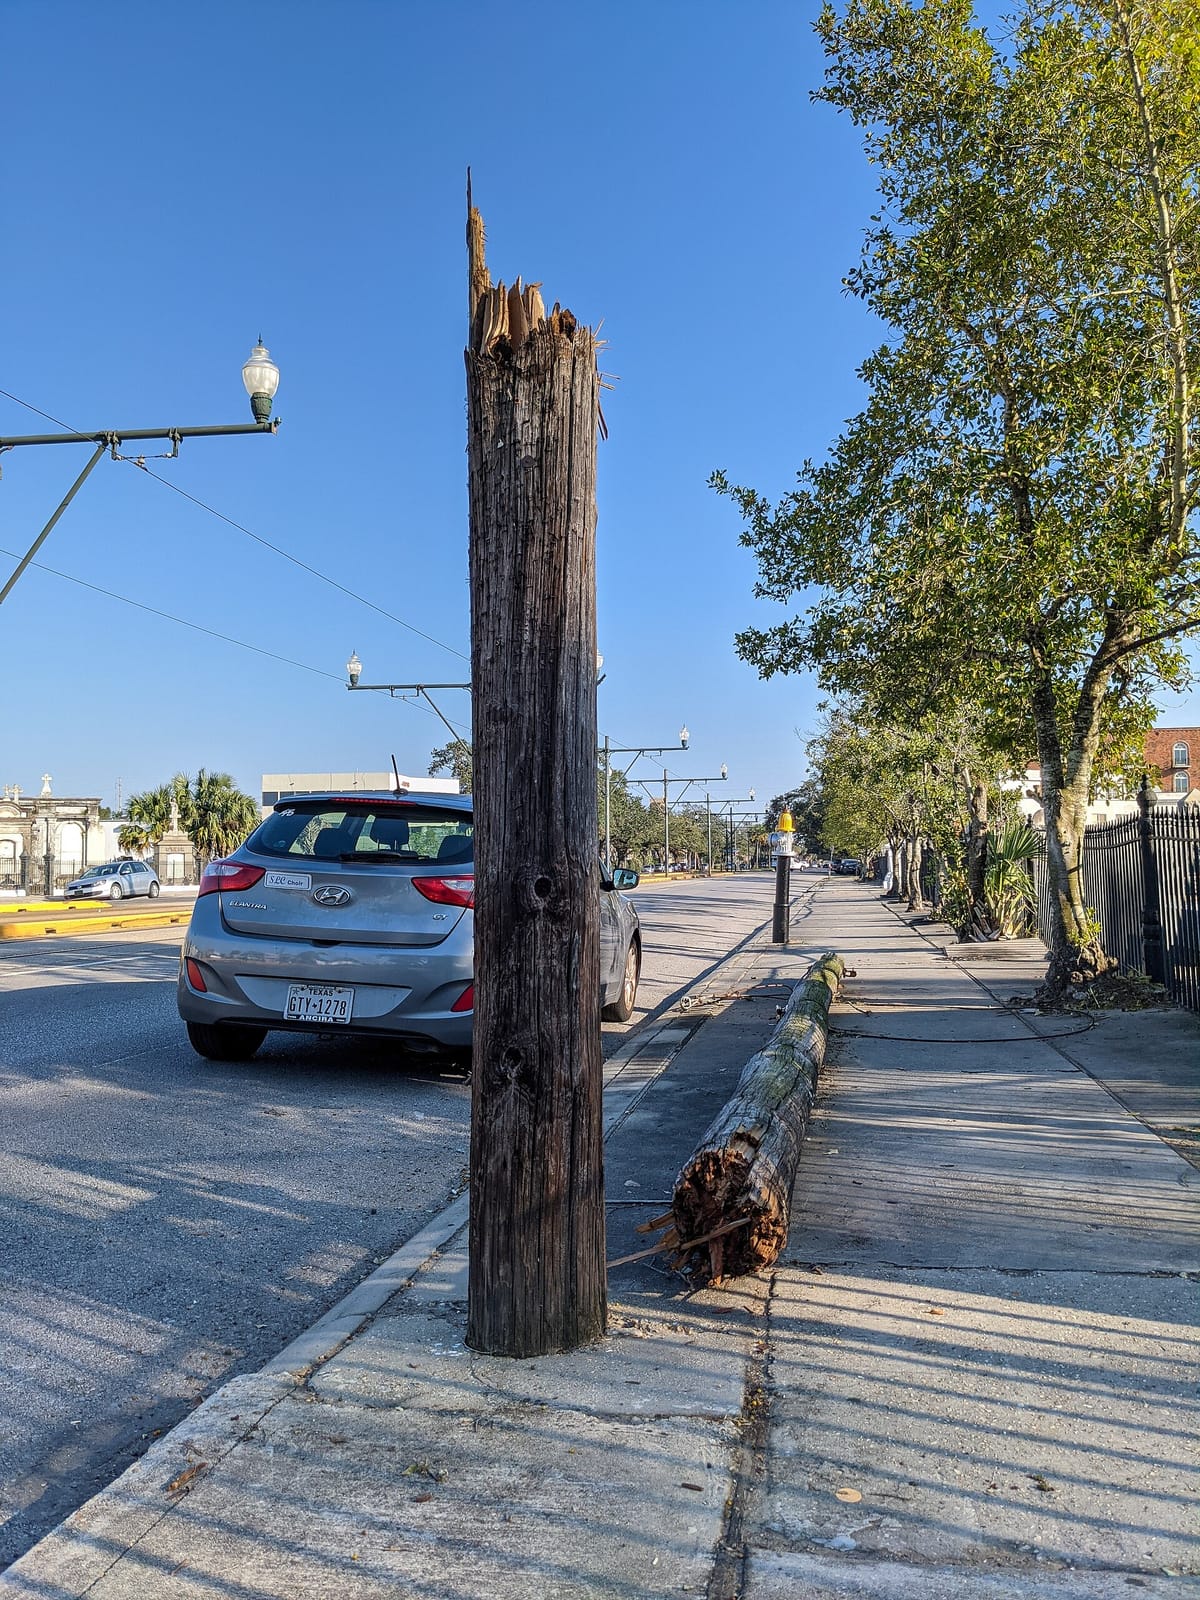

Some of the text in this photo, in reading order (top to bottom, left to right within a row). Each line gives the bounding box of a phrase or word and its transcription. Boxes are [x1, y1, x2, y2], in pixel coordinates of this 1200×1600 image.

[229, 900, 267, 910] ELANTRA
[309, 988, 334, 996] TEXAS
[299, 1014, 333, 1022] ANCIRA
